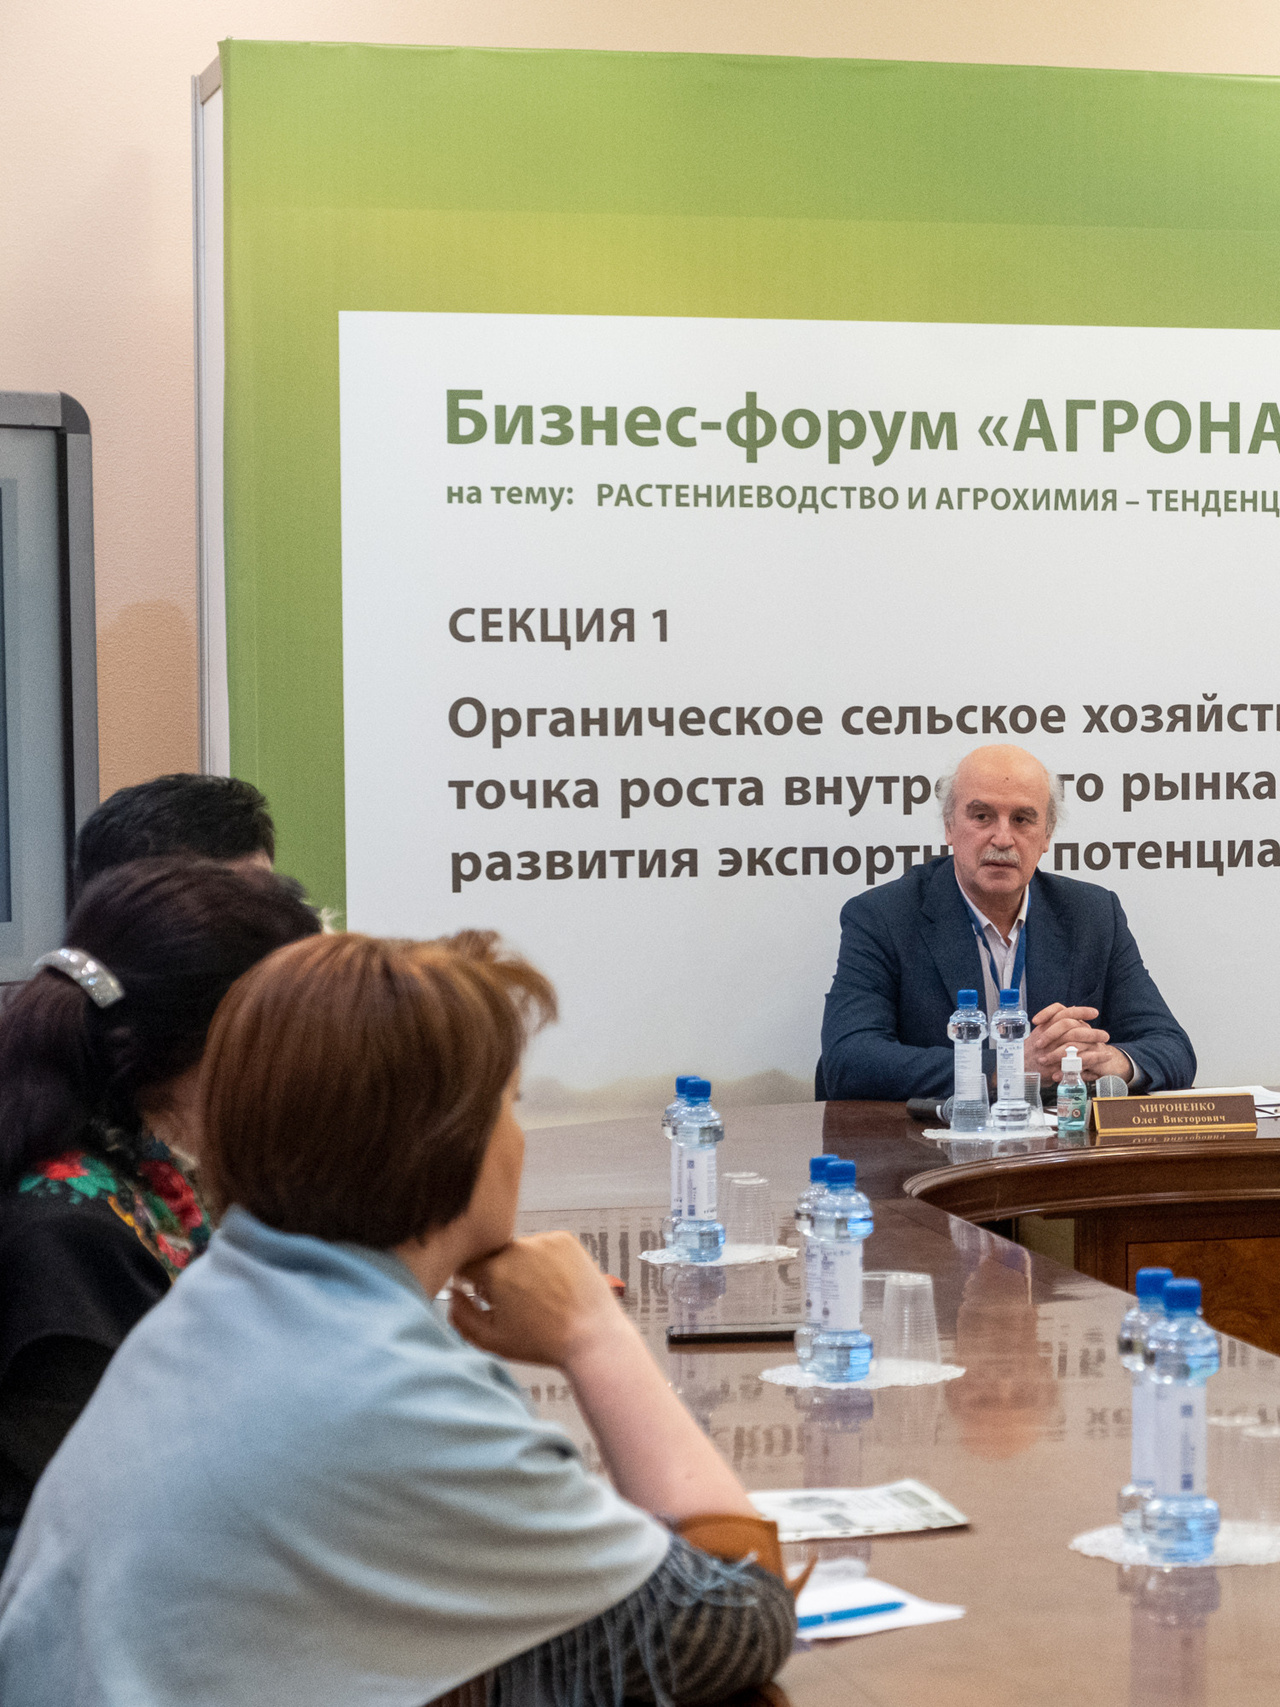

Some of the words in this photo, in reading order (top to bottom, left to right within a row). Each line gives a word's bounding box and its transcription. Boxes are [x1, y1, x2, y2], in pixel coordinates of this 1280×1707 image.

[446, 389, 958, 467] Бизнес-форум
[446, 485, 482, 505] на
[490, 486, 574, 512] тему:
[597, 483, 899, 515] РАСТЕНИЕВОДСТВО
[908, 486, 927, 510] И
[935, 487, 1117, 512] АГРОХИМИЯ
[448, 607, 635, 651] СЕКЦИЯ
[652, 609, 668, 643] 1
[448, 696, 823, 749] Органическое
[841, 704, 1066, 736] сельское
[447, 778, 599, 810] точка
[620, 776, 764, 819] роста
[784, 770, 1105, 818] внутрго
[1122, 770, 1277, 813] рынка
[451, 848, 698, 894] развития
[1132, 1116, 1158, 1125] Олег
[1163, 1115, 1226, 1124] Викторович
[1140, 1102, 1215, 1113] МИРОНЕНКО
